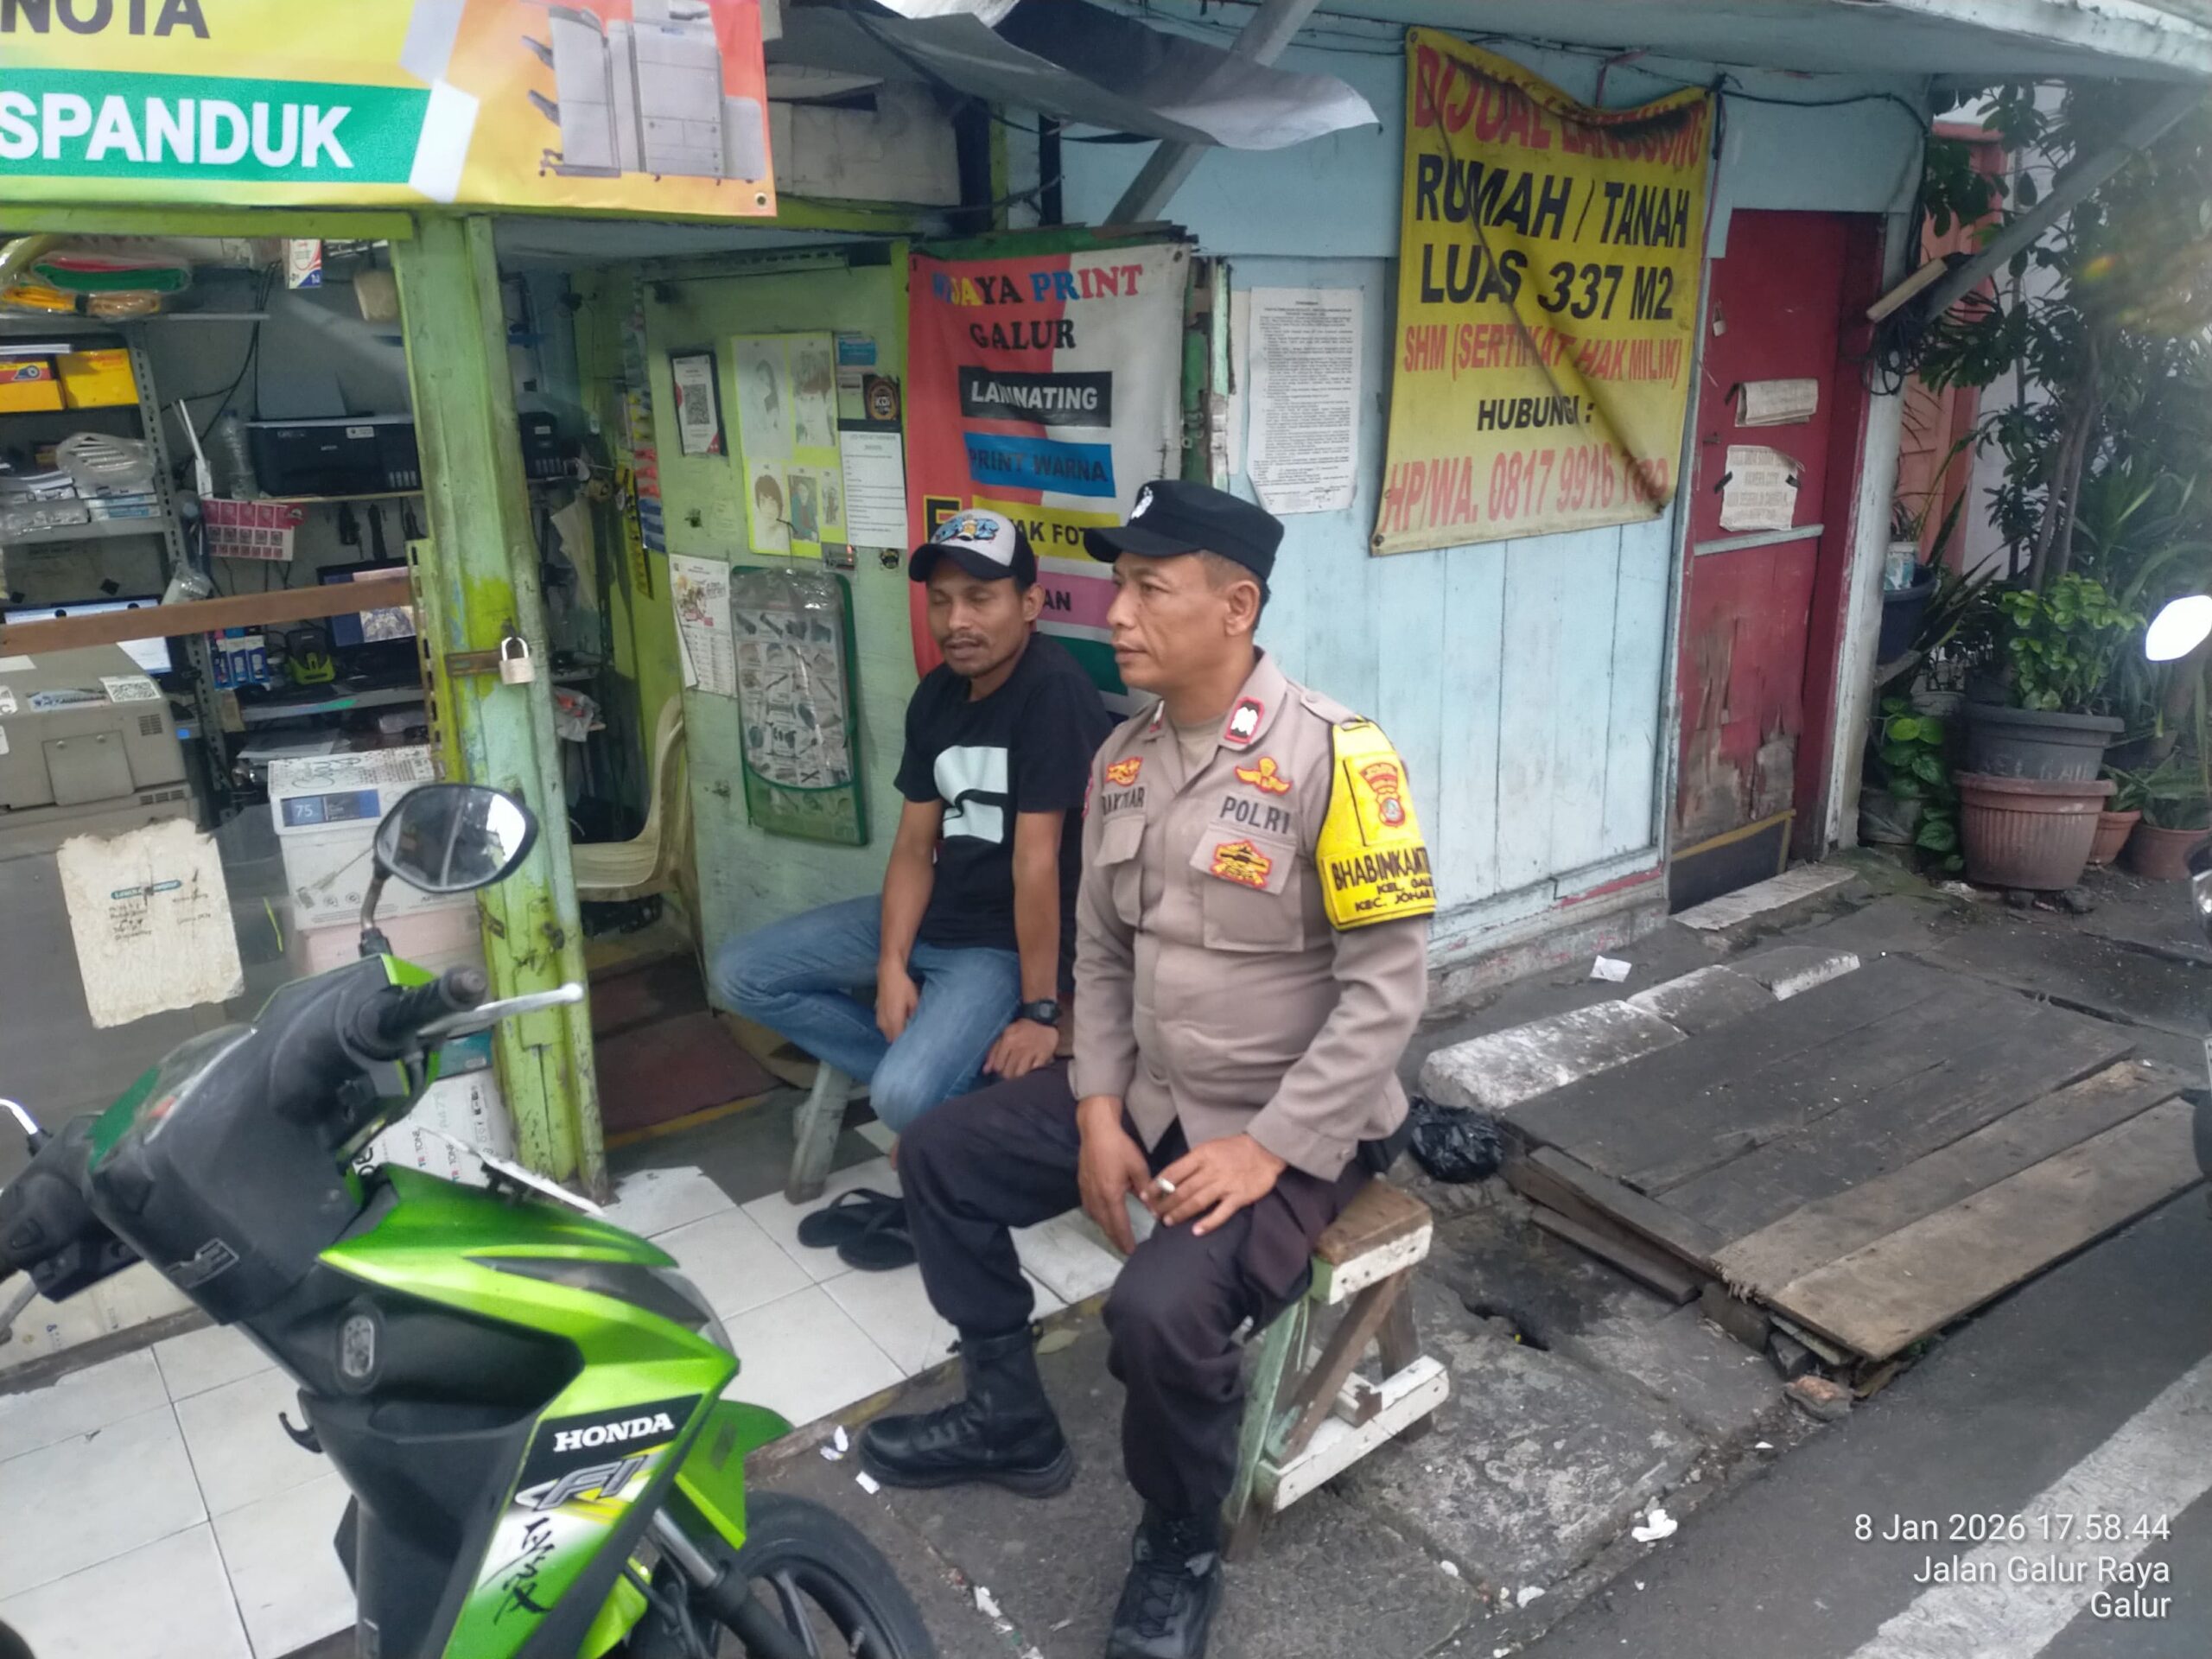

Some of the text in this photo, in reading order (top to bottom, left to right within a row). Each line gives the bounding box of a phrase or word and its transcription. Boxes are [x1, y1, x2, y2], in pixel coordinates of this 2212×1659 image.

[0, 94, 353, 170] SPANDUK
[1415, 153, 1573, 240] RUMAH
[1599, 181, 1690, 248] TANAH
[1029, 264, 1143, 302] PRINT
[1421, 244, 1674, 320] LUAS 337 M2
[969, 319, 1077, 350] GALUR
[1403, 325, 1448, 372] SHM
[1574, 338, 1627, 380] HAK
[968, 448, 1109, 482] PRINT WARNA
[1487, 449, 1556, 521] 0817
[1556, 442, 1616, 512] 9916
[295, 804, 314, 817] 75
[1219, 797, 1292, 836] POLRI
[553, 1412, 675, 1452] HONDA
